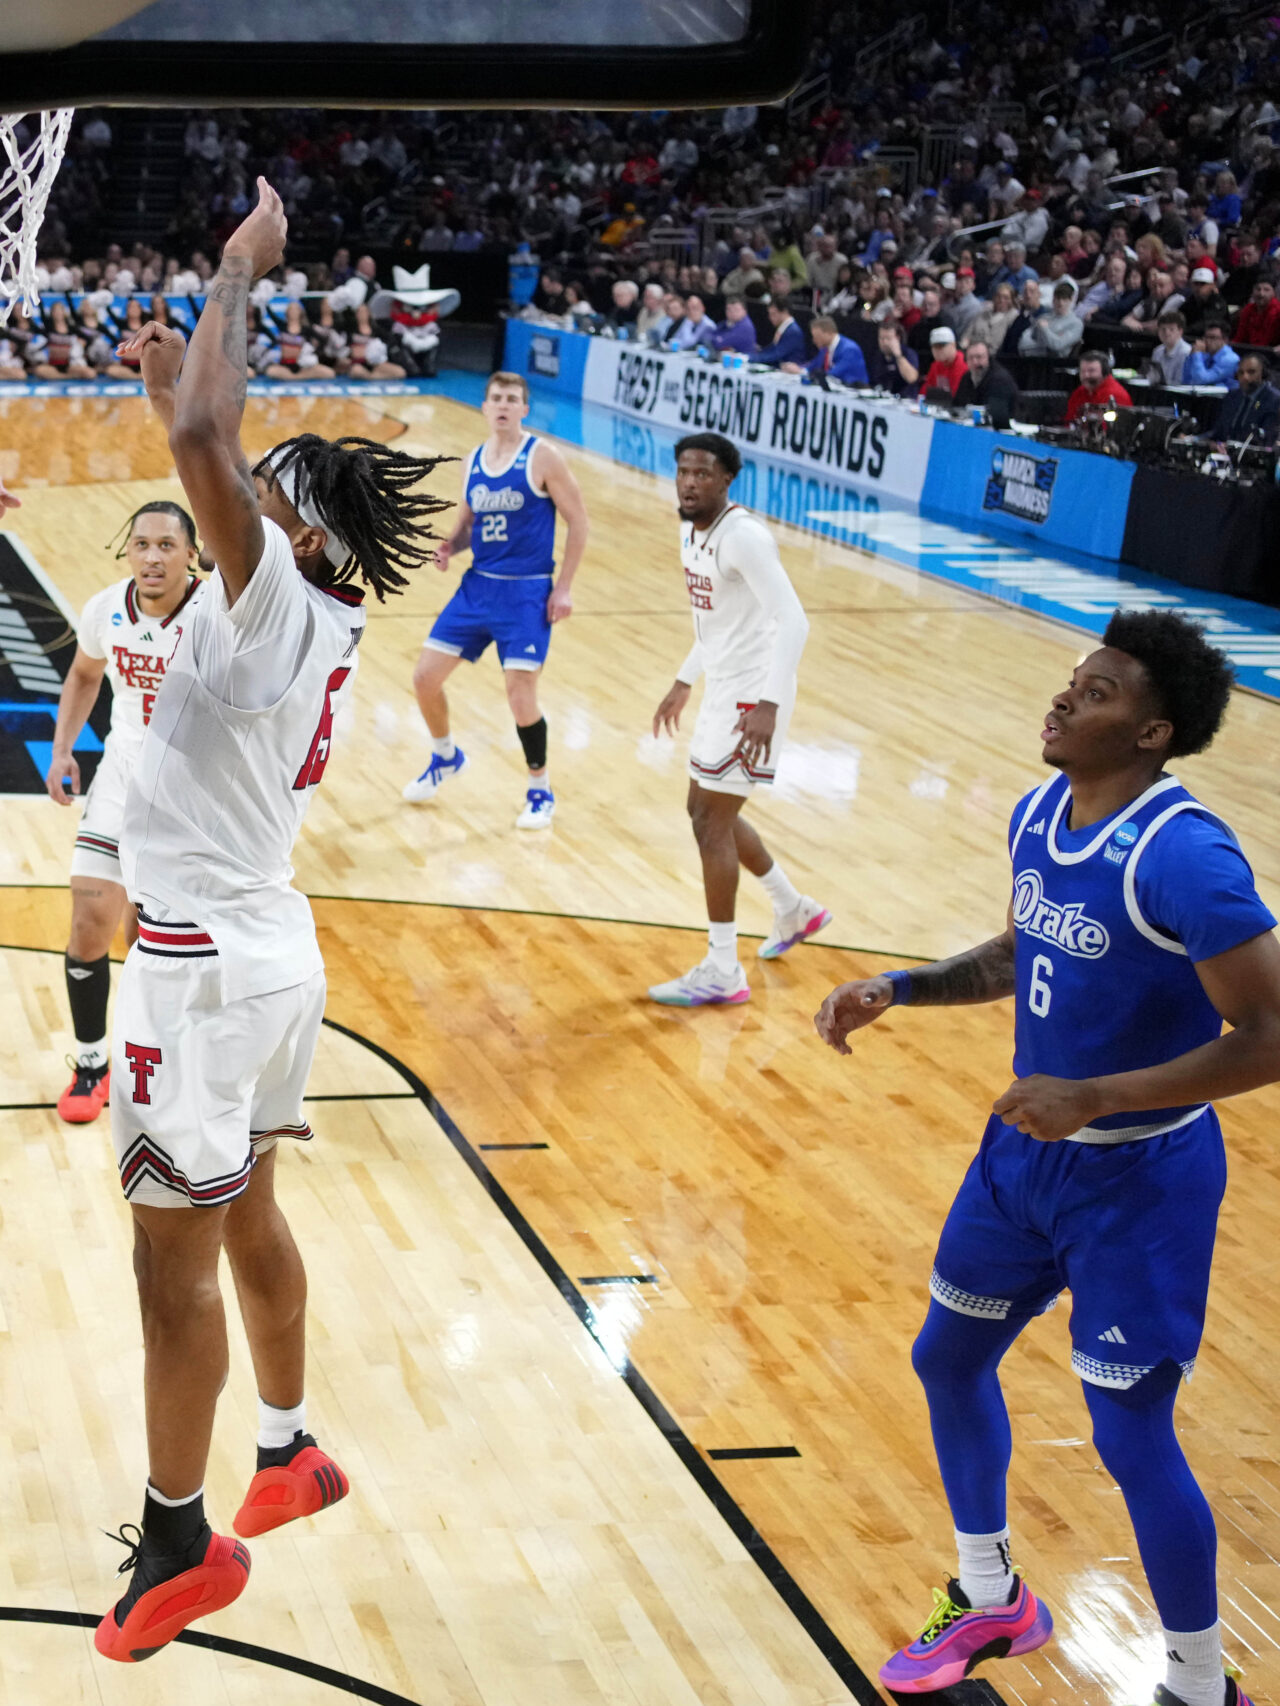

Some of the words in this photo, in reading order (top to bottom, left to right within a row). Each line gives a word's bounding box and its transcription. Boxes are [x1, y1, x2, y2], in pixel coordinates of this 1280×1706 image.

[614, 351, 665, 414] FIRST
[680, 367, 765, 444] SECOND
[770, 391, 889, 479] ROUNDS
[1001, 452, 1037, 486] MARCH
[469, 483, 525, 514] Drake
[1003, 479, 1050, 517] MADNESS
[481, 513, 509, 543] 22
[112, 645, 171, 675] TEXA
[120, 668, 163, 692] TEC
[1116, 829, 1137, 844] NCAA
[1012, 868, 1111, 960] Drake
[1028, 953, 1054, 1019] 6
